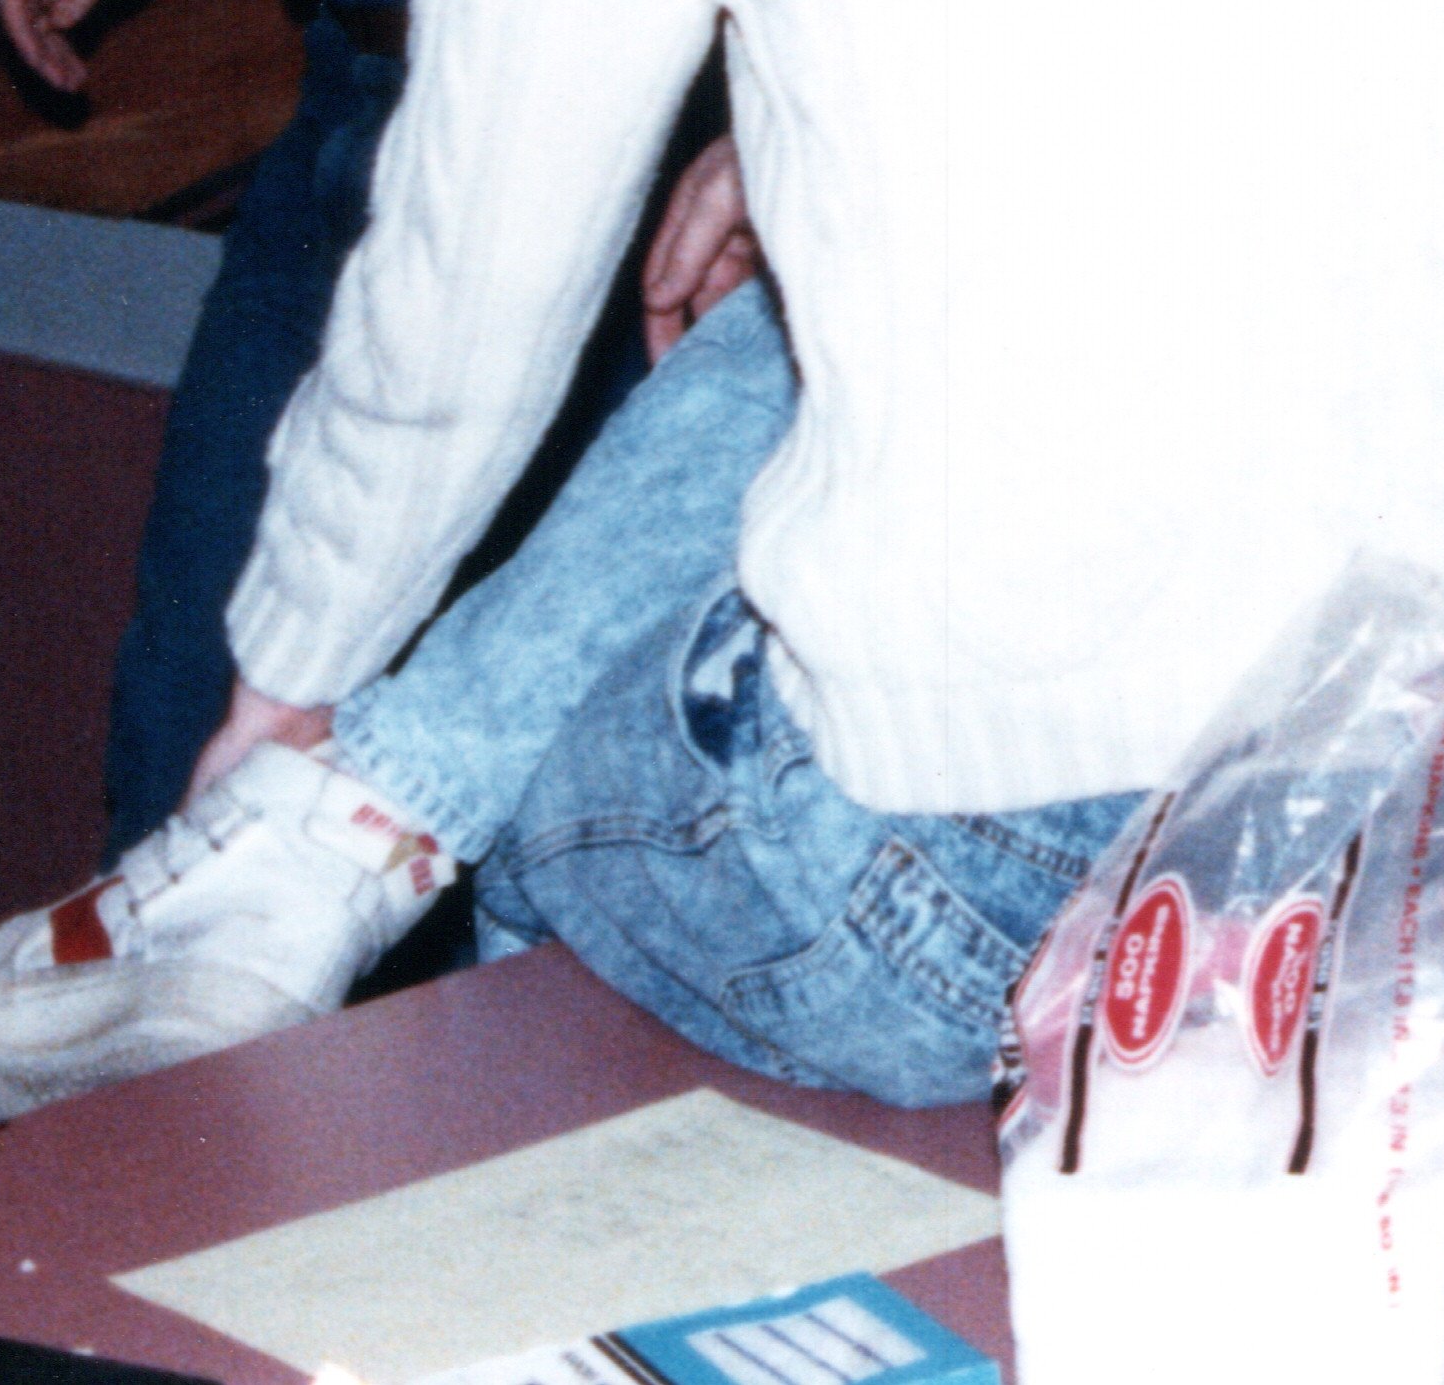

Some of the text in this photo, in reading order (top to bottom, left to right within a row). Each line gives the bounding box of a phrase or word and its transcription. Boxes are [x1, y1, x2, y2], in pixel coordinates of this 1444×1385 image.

[1397, 882, 1423, 954] EACH
[1115, 933, 1145, 1000] 500
[1132, 904, 1171, 1040] NAPKINS
